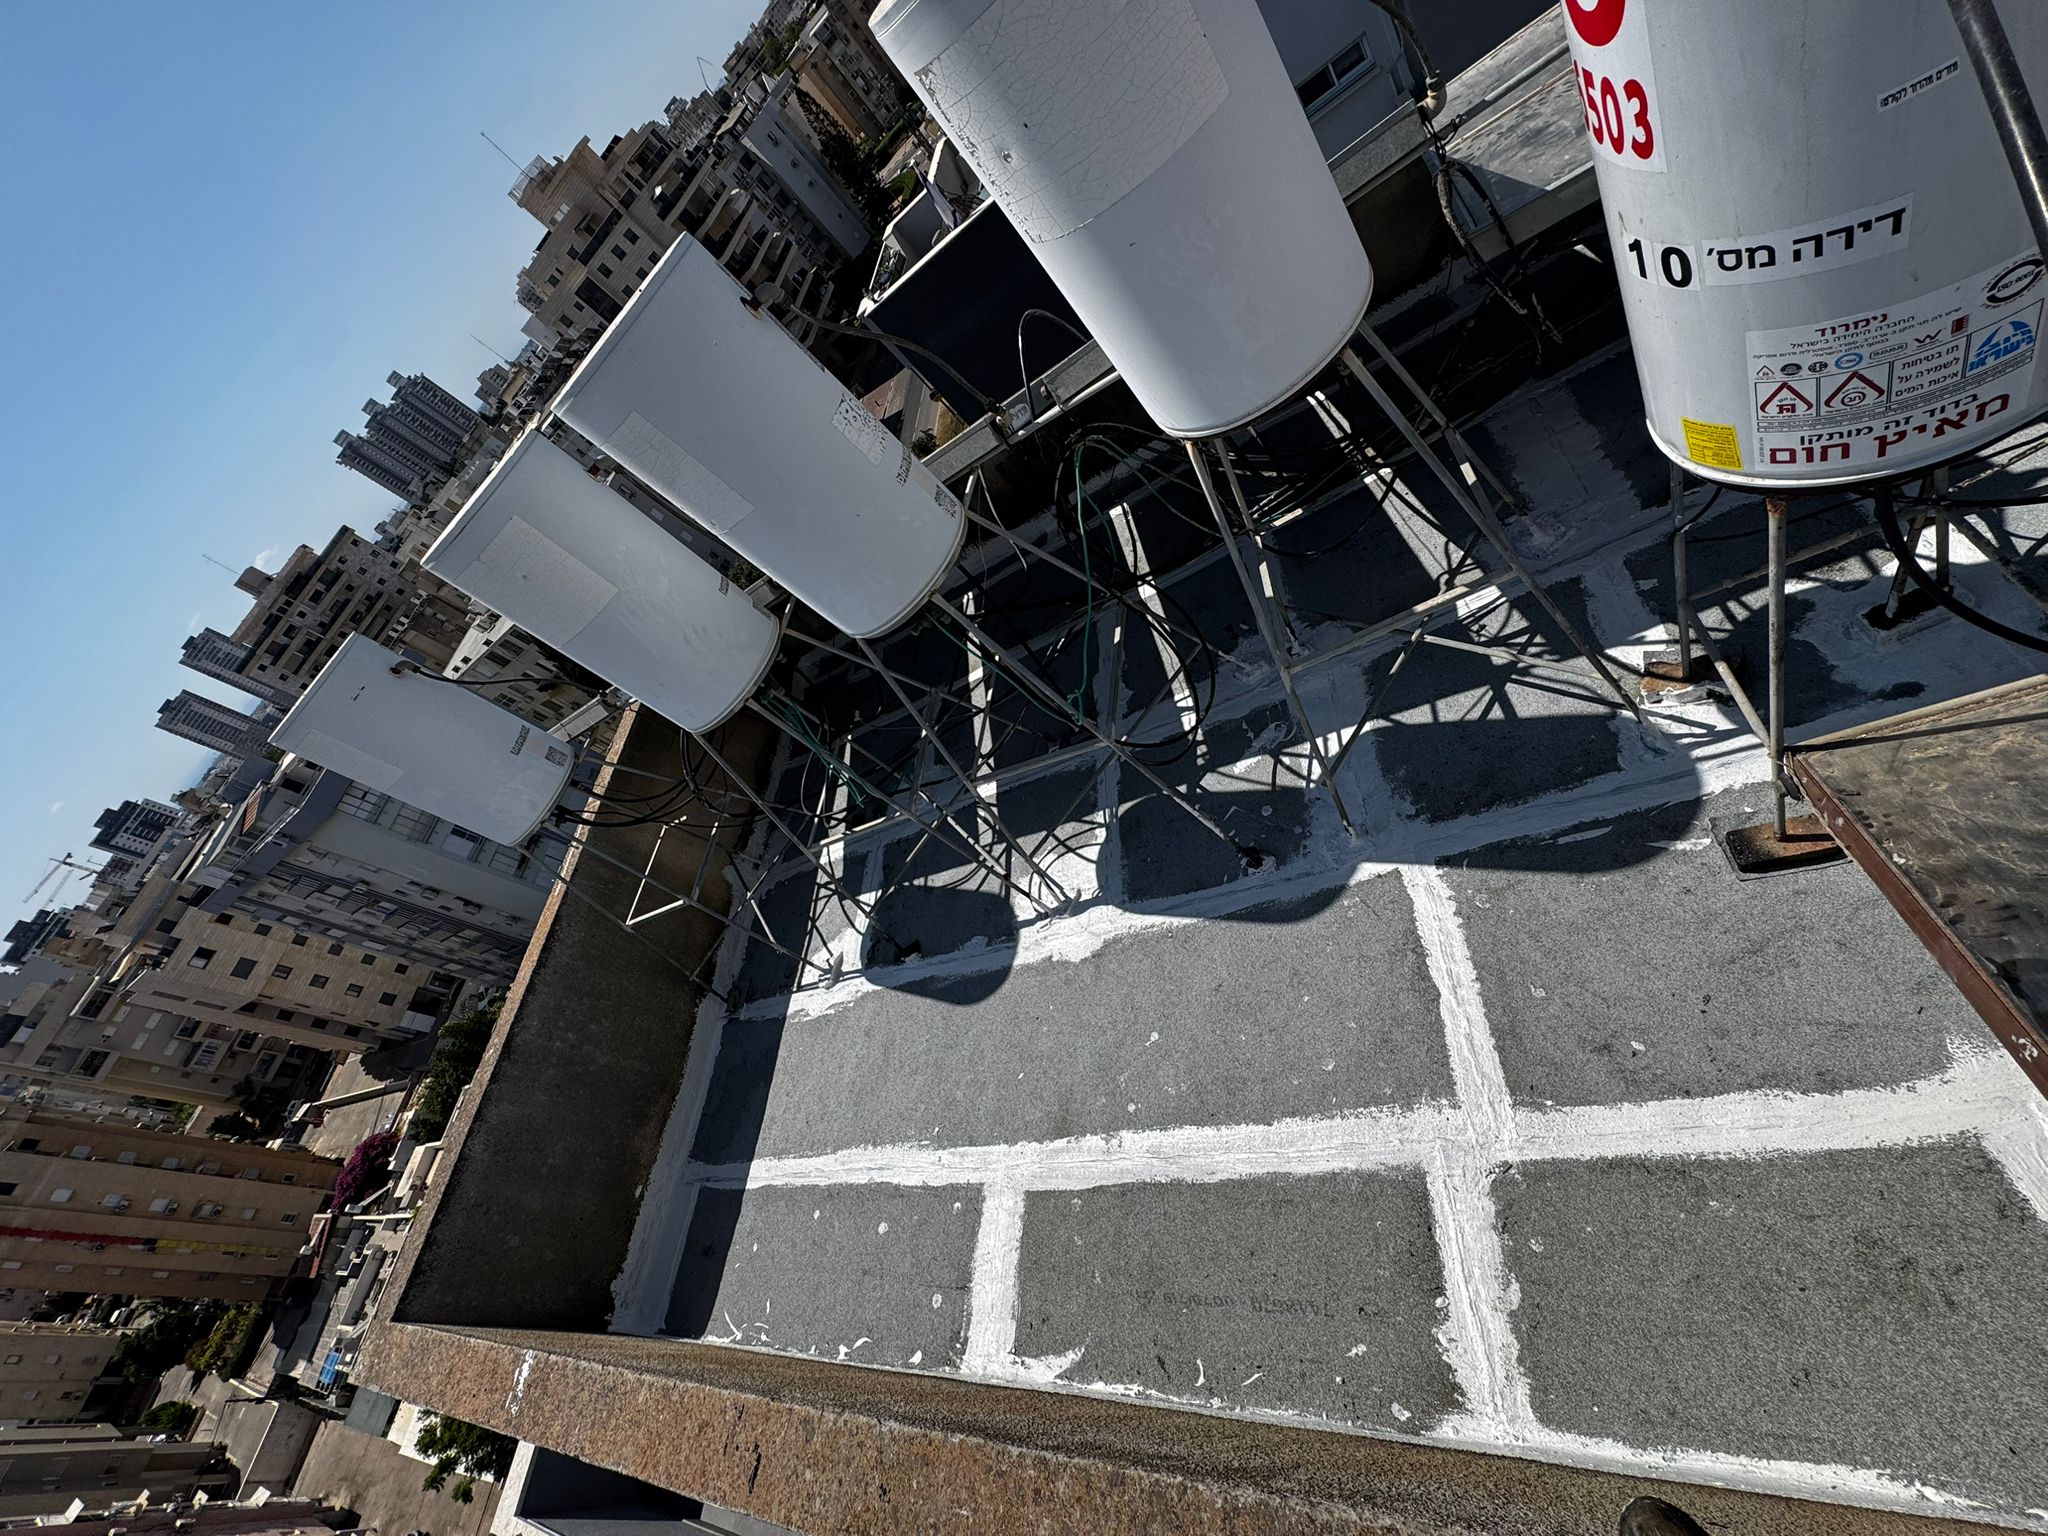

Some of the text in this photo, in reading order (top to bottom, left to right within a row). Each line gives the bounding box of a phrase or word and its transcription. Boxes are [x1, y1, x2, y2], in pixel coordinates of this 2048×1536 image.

[1628, 207, 1906, 288] דירה מס' 10
[1790, 315, 1915, 349] החברה היחידה בישראל
[1814, 313, 1888, 338] נימרוד
[1946, 344, 1960, 353] תו
[1901, 351, 1942, 370] בטיחות
[1915, 356, 1960, 379] לשמירה
[1895, 370, 1960, 397] איכות המים
[1897, 374, 1912, 384] על
[1923, 393, 1979, 418] בדוד
[1873, 393, 2011, 458] מאיץ
[1884, 415, 1914, 431] זה
[1800, 426, 1874, 446] מותקן
[1769, 442, 1851, 464] חום
